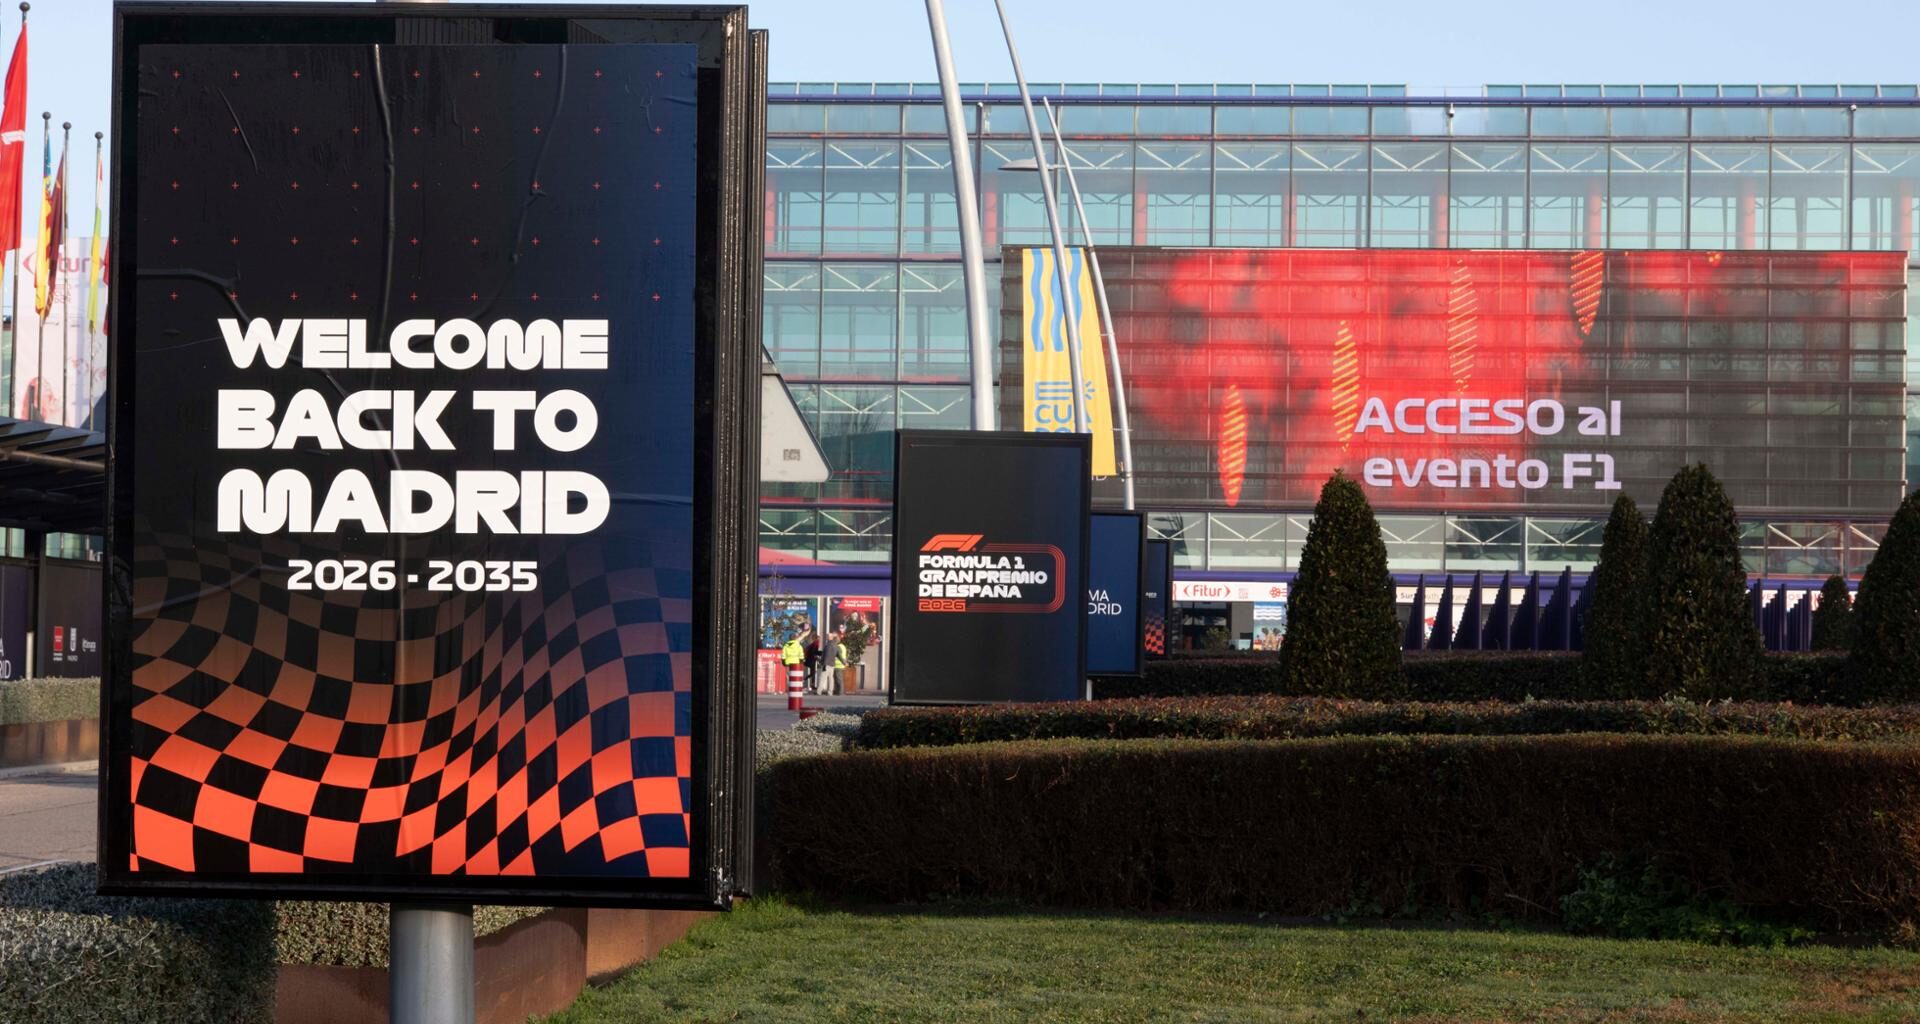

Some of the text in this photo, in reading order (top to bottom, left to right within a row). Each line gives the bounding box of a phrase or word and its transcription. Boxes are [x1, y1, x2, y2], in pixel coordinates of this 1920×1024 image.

[217, 318, 609, 370] WELCOME
[217, 388, 598, 452] BACK TO
[1354, 397, 1621, 436] ACCESO al
[1363, 453, 1622, 489] evento F1
[217, 468, 610, 534] MADRID
[287, 560, 396, 591] 2026
[428, 561, 538, 592] 2035
[919, 555, 1025, 569] FORMULA 1
[919, 570, 1048, 584] GRAN PREMIO
[919, 583, 1022, 598] DE ESPAÑA
[920, 599, 965, 611] 2026
[1193, 584, 1222, 597] Fitur
